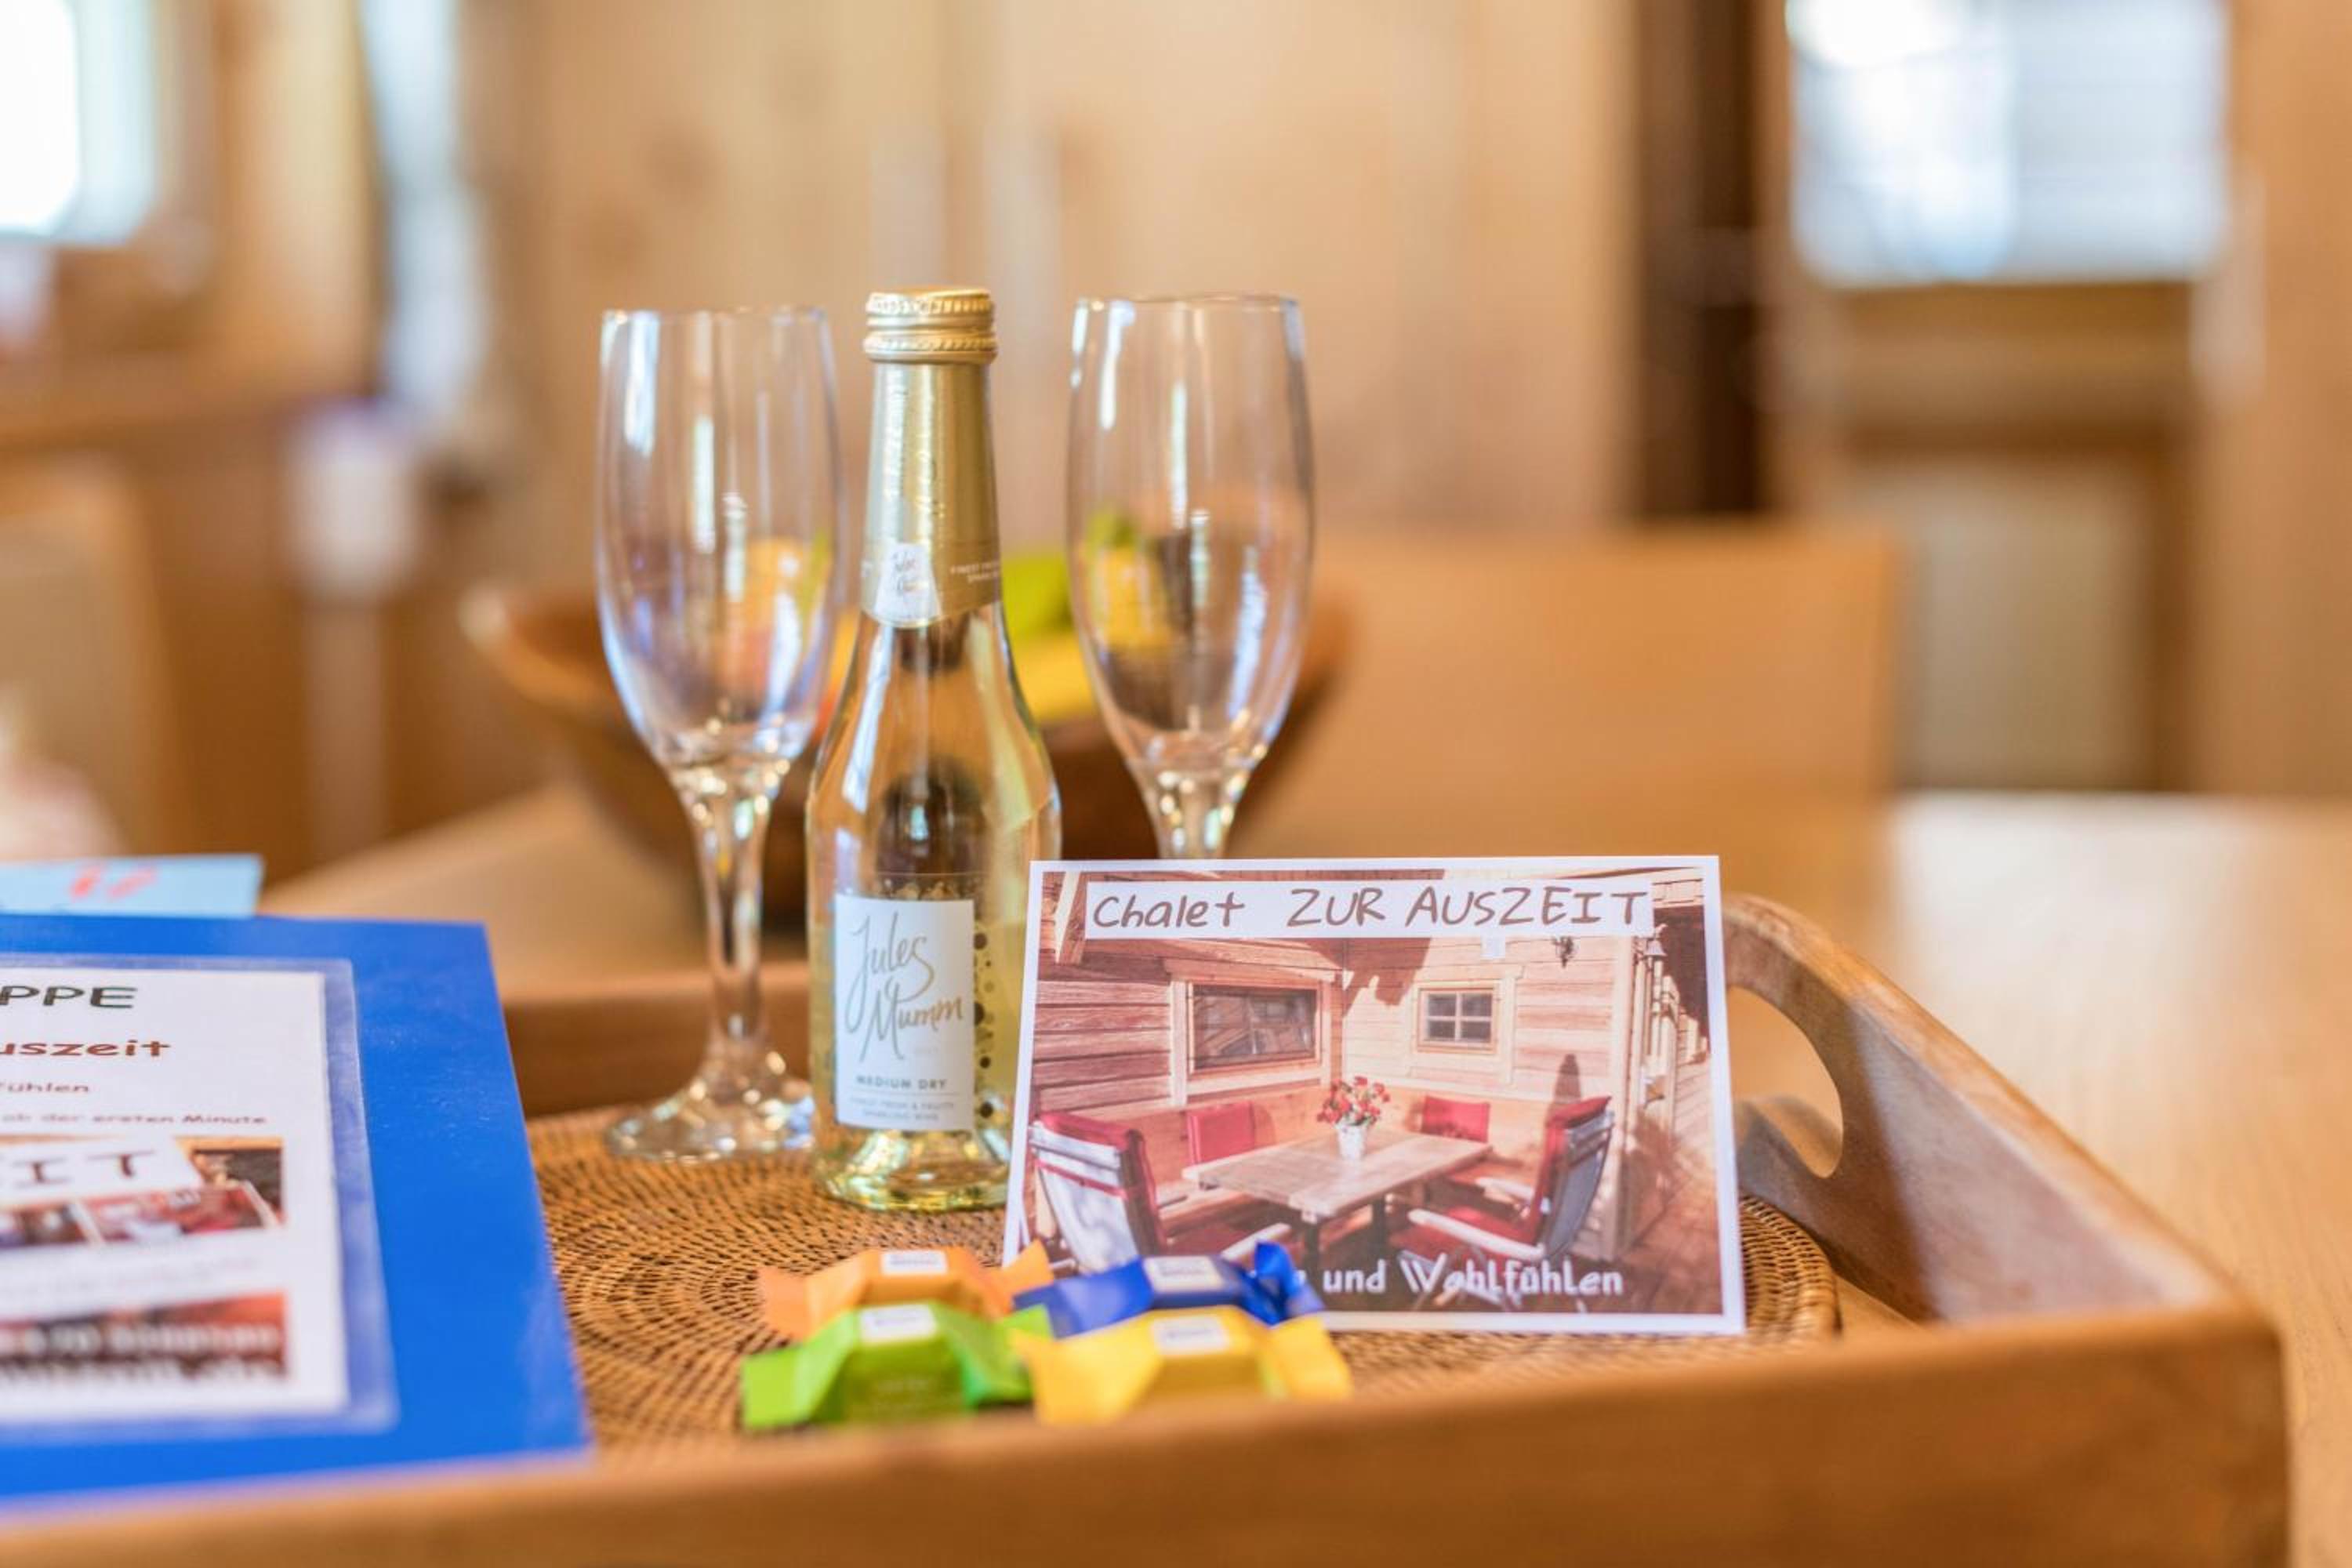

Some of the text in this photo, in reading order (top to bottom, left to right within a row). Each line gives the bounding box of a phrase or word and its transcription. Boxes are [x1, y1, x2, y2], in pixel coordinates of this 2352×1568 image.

[1093, 885, 1649, 928] Chalet ZUR AUSZEIT
[844, 911, 935, 1033] Jules
[0, 985, 137, 1009] PPE
[858, 982, 964, 1063] Mumm
[855, 1075, 947, 1090] MEDIUM DRY
[1323, 1258, 1387, 1294] und
[1400, 1253, 1624, 1296] Wohlfühlen
